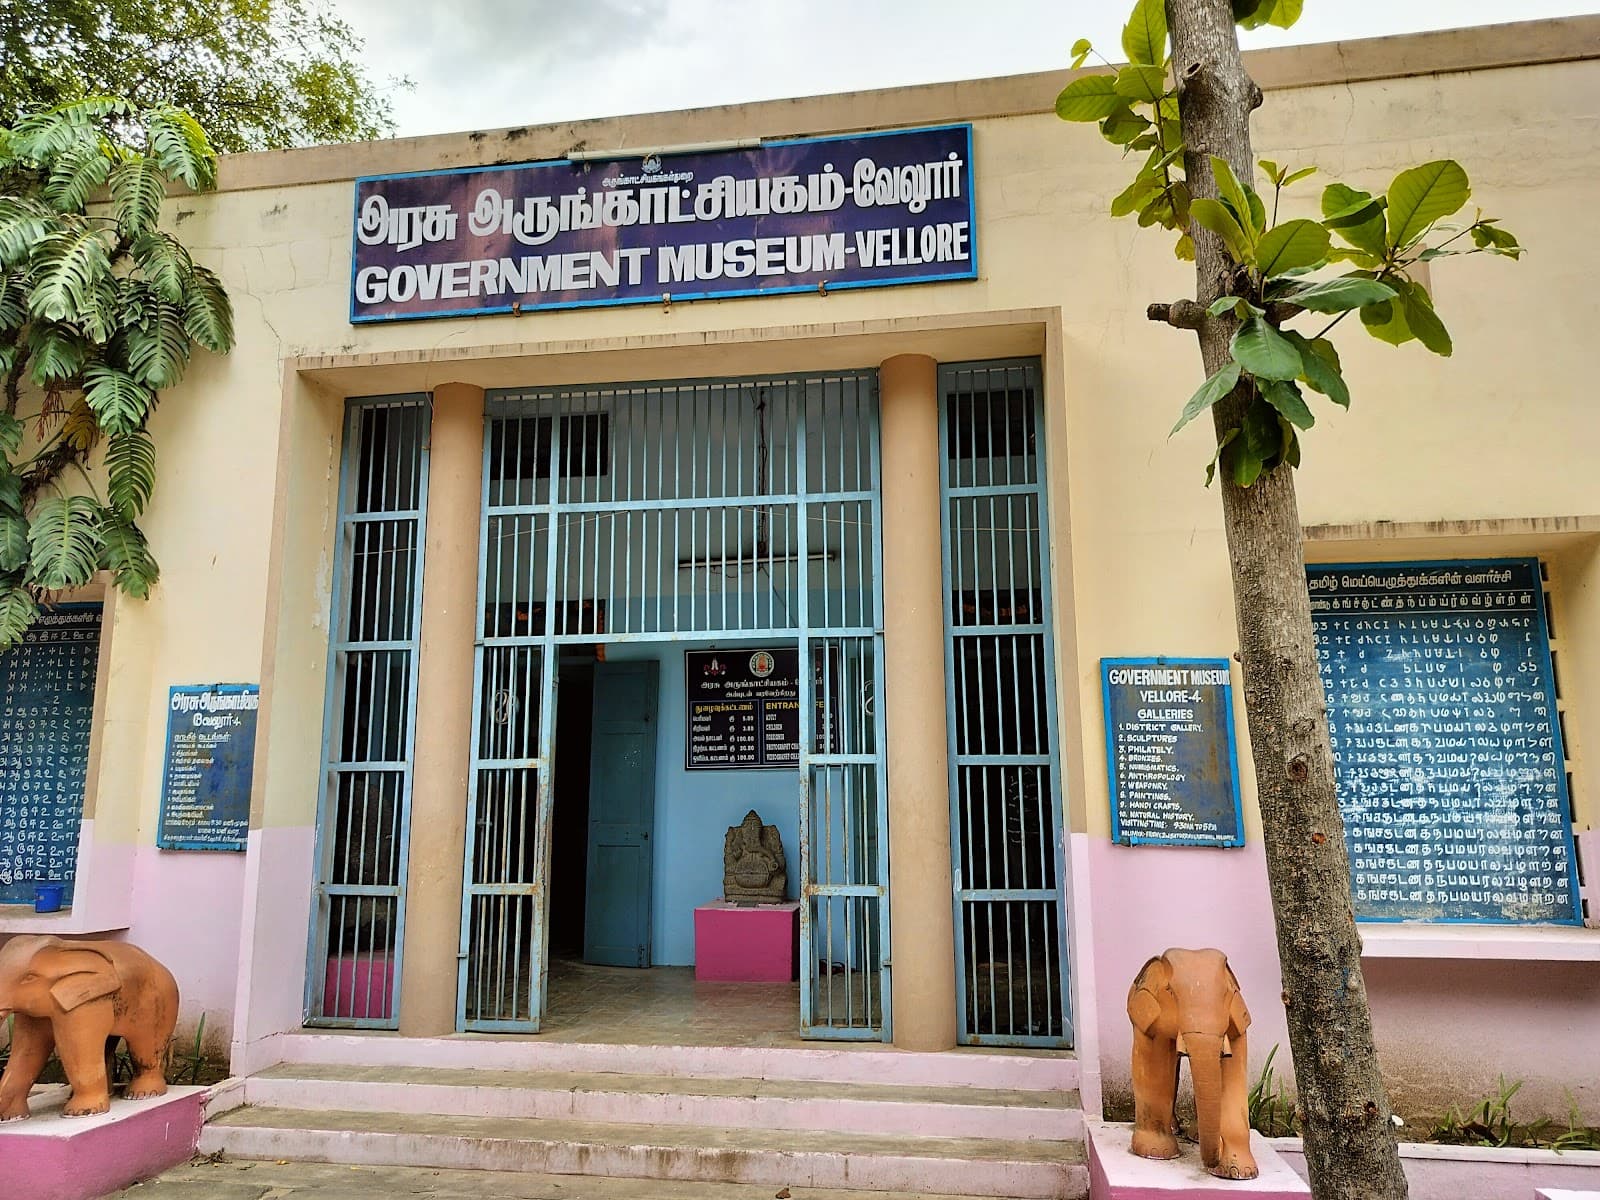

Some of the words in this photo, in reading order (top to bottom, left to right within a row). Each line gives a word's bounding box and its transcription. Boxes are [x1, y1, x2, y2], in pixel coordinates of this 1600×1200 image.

[357, 194, 458, 252] அரசு
[355, 248, 650, 304] GOVERNMENT
[1309, 576, 1338, 591] தமிழ்
[1109, 669, 1189, 685] GOVERNMENT
[1191, 670, 1230, 685] MUSEUM
[766, 702, 800, 710] ENTRAN
[1137, 709, 1193, 720] GALLERIES
[1126, 723, 1166, 731] DISTRICT
[1127, 734, 1178, 743] SCULPTURES
[1128, 772, 1186, 782] ANTHROPOLOGY
